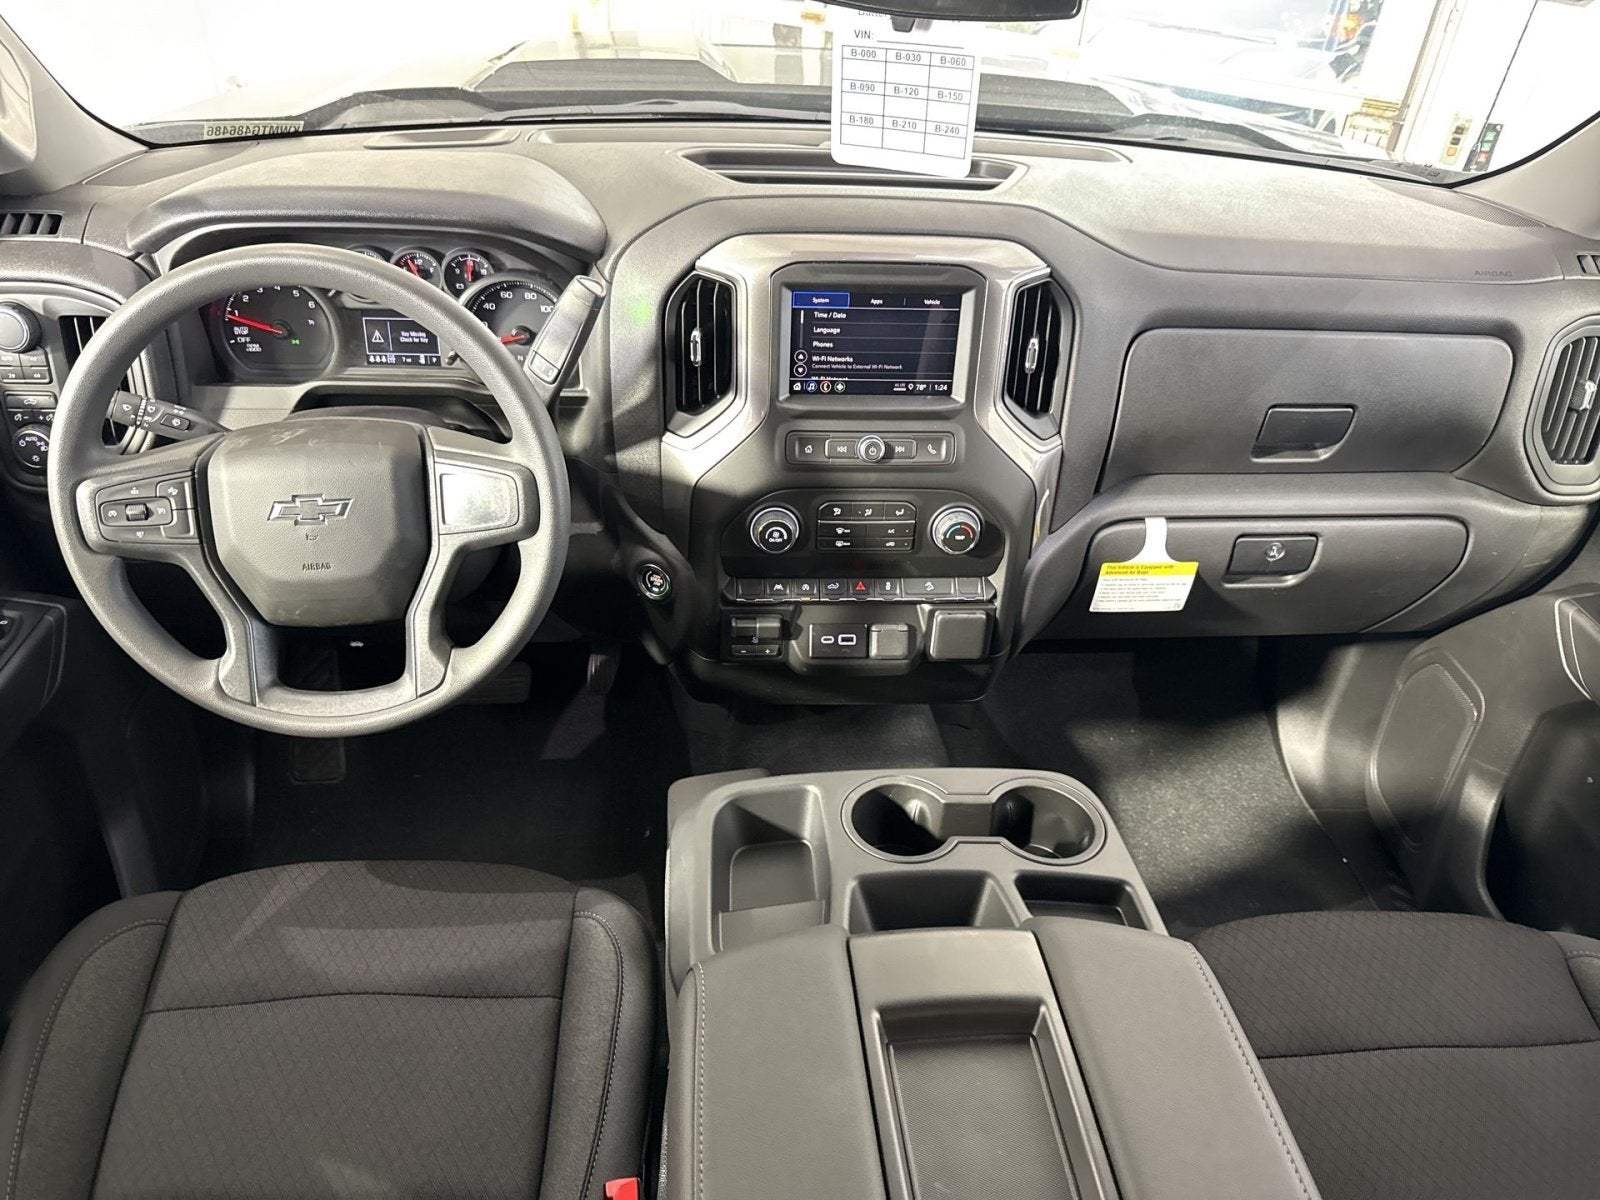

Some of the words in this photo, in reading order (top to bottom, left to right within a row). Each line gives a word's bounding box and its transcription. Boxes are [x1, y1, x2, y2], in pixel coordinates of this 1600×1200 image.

[854, 30, 874, 40] VIN:
[851, 49, 877, 59] B-000
[895, 52, 922, 62] B-030
[940, 56, 966, 66] B-060
[850, 82, 876, 92] B-090
[893, 86, 920, 96] B-120
[937, 91, 963, 101] B-150
[849, 115, 874, 125] B-180
[892, 119, 917, 130] B-210
[934, 124, 960, 135] B-240
[500, 291, 513, 299] 60
[524, 292, 537, 300] 80
[308, 301, 315, 309] 6
[483, 302, 496, 310] 40
[812, 297, 830, 305] System
[870, 298, 883, 306] Apps
[813, 326, 841, 334] Language
[301, 562, 332, 571] AIRBAG
